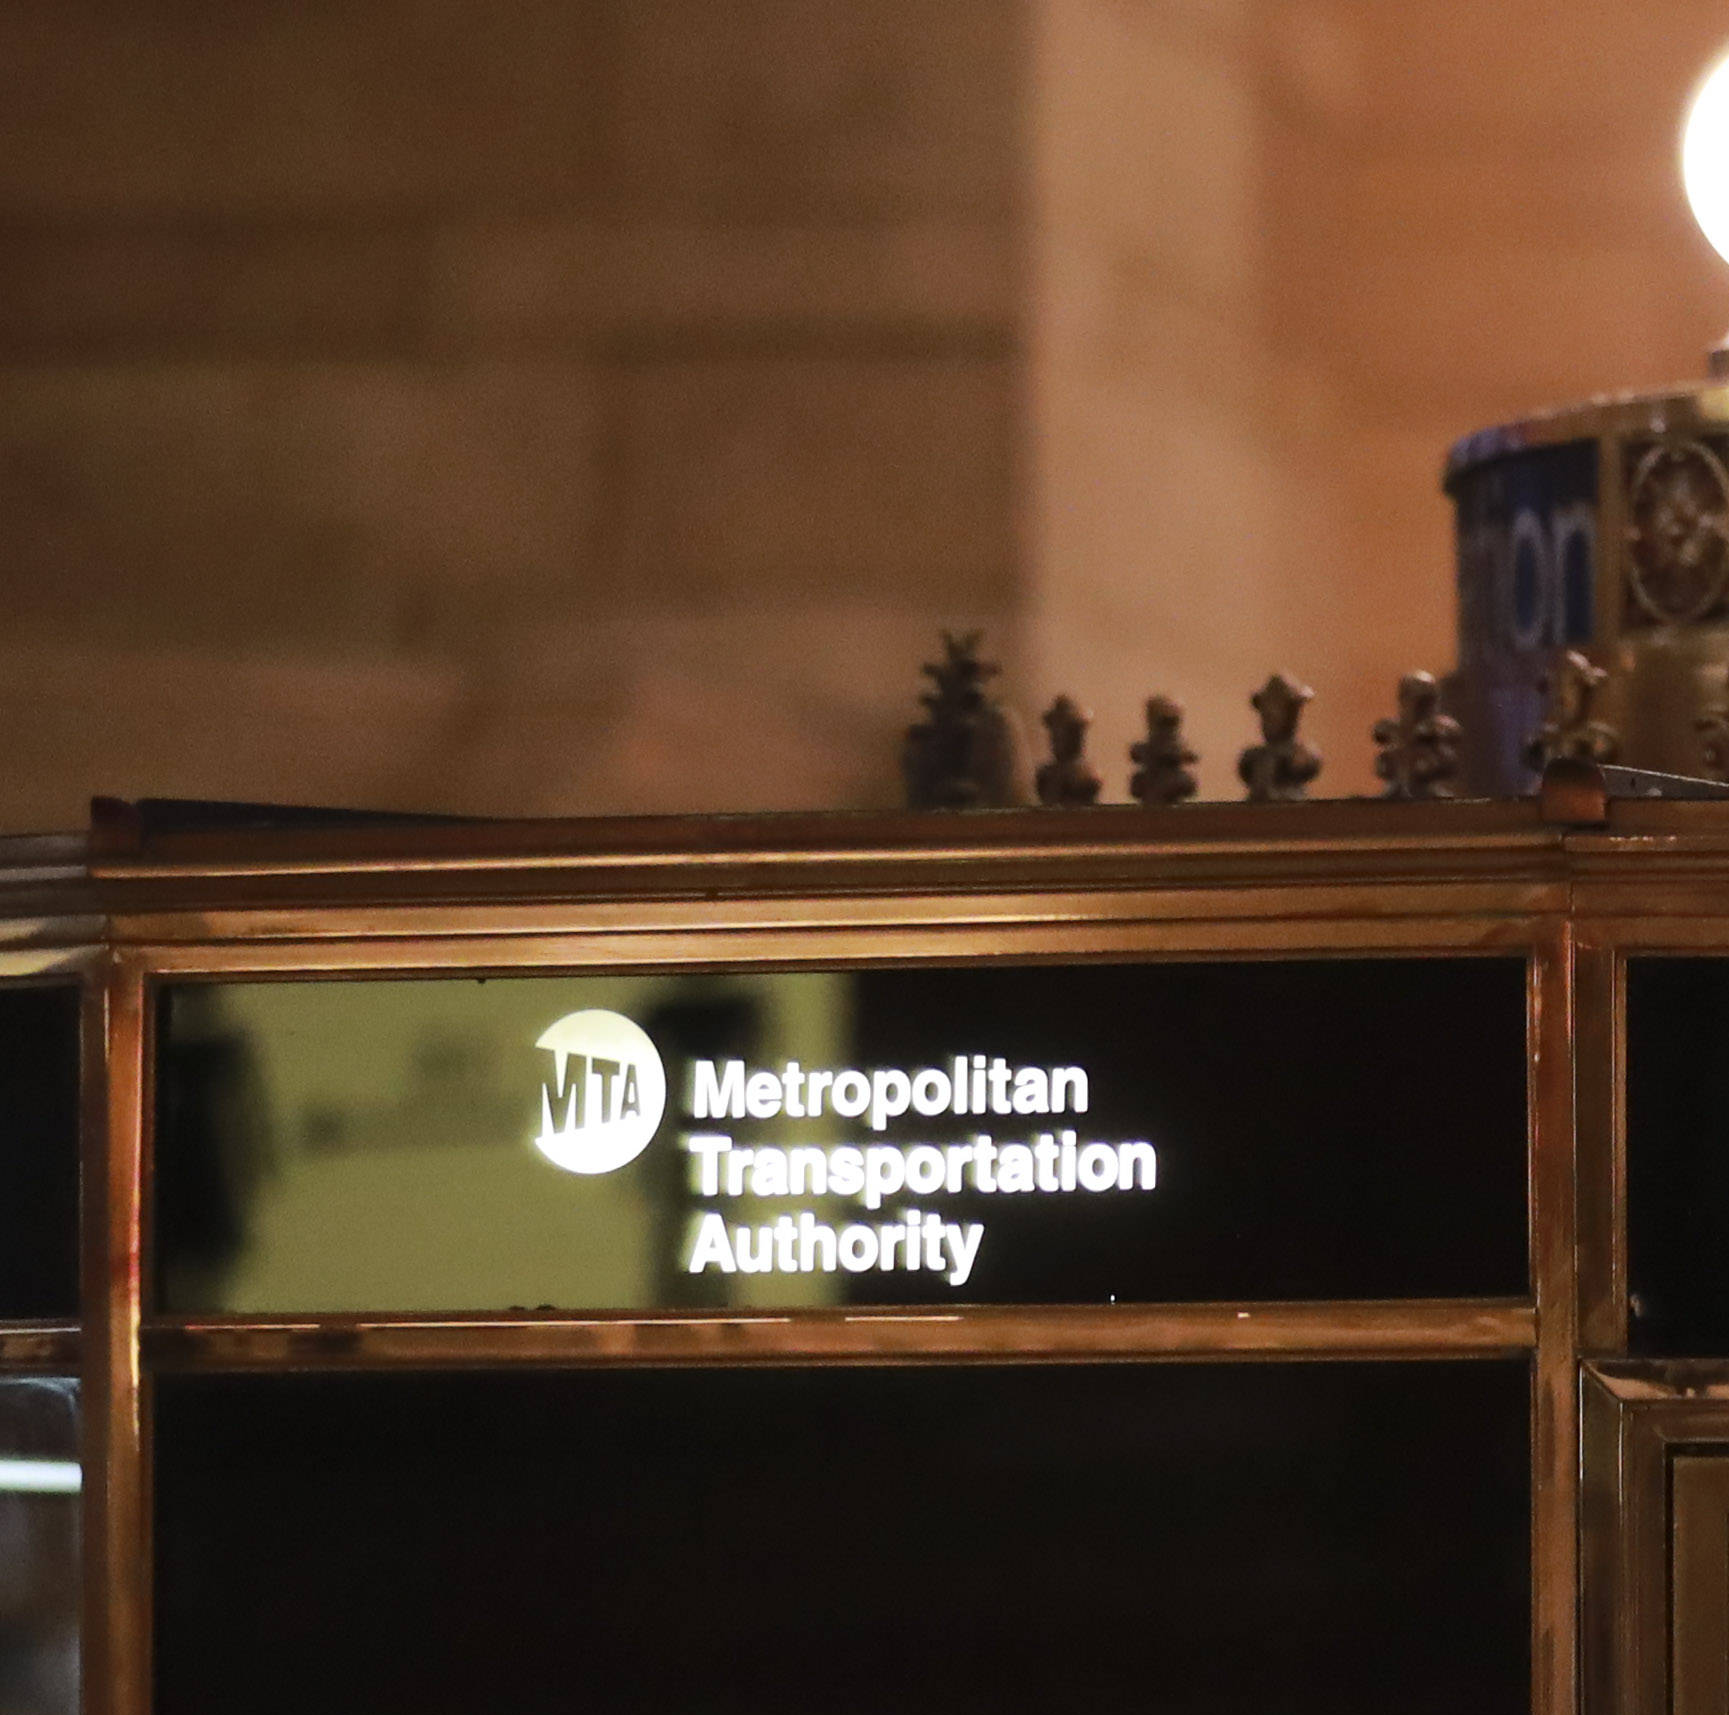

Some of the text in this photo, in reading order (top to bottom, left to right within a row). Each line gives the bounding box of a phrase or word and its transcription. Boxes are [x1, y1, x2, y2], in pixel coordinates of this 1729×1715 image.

[691, 1054, 1090, 1131] Metropolitan
[688, 1130, 1158, 1209] Transportation
[688, 1210, 986, 1287] Authority
